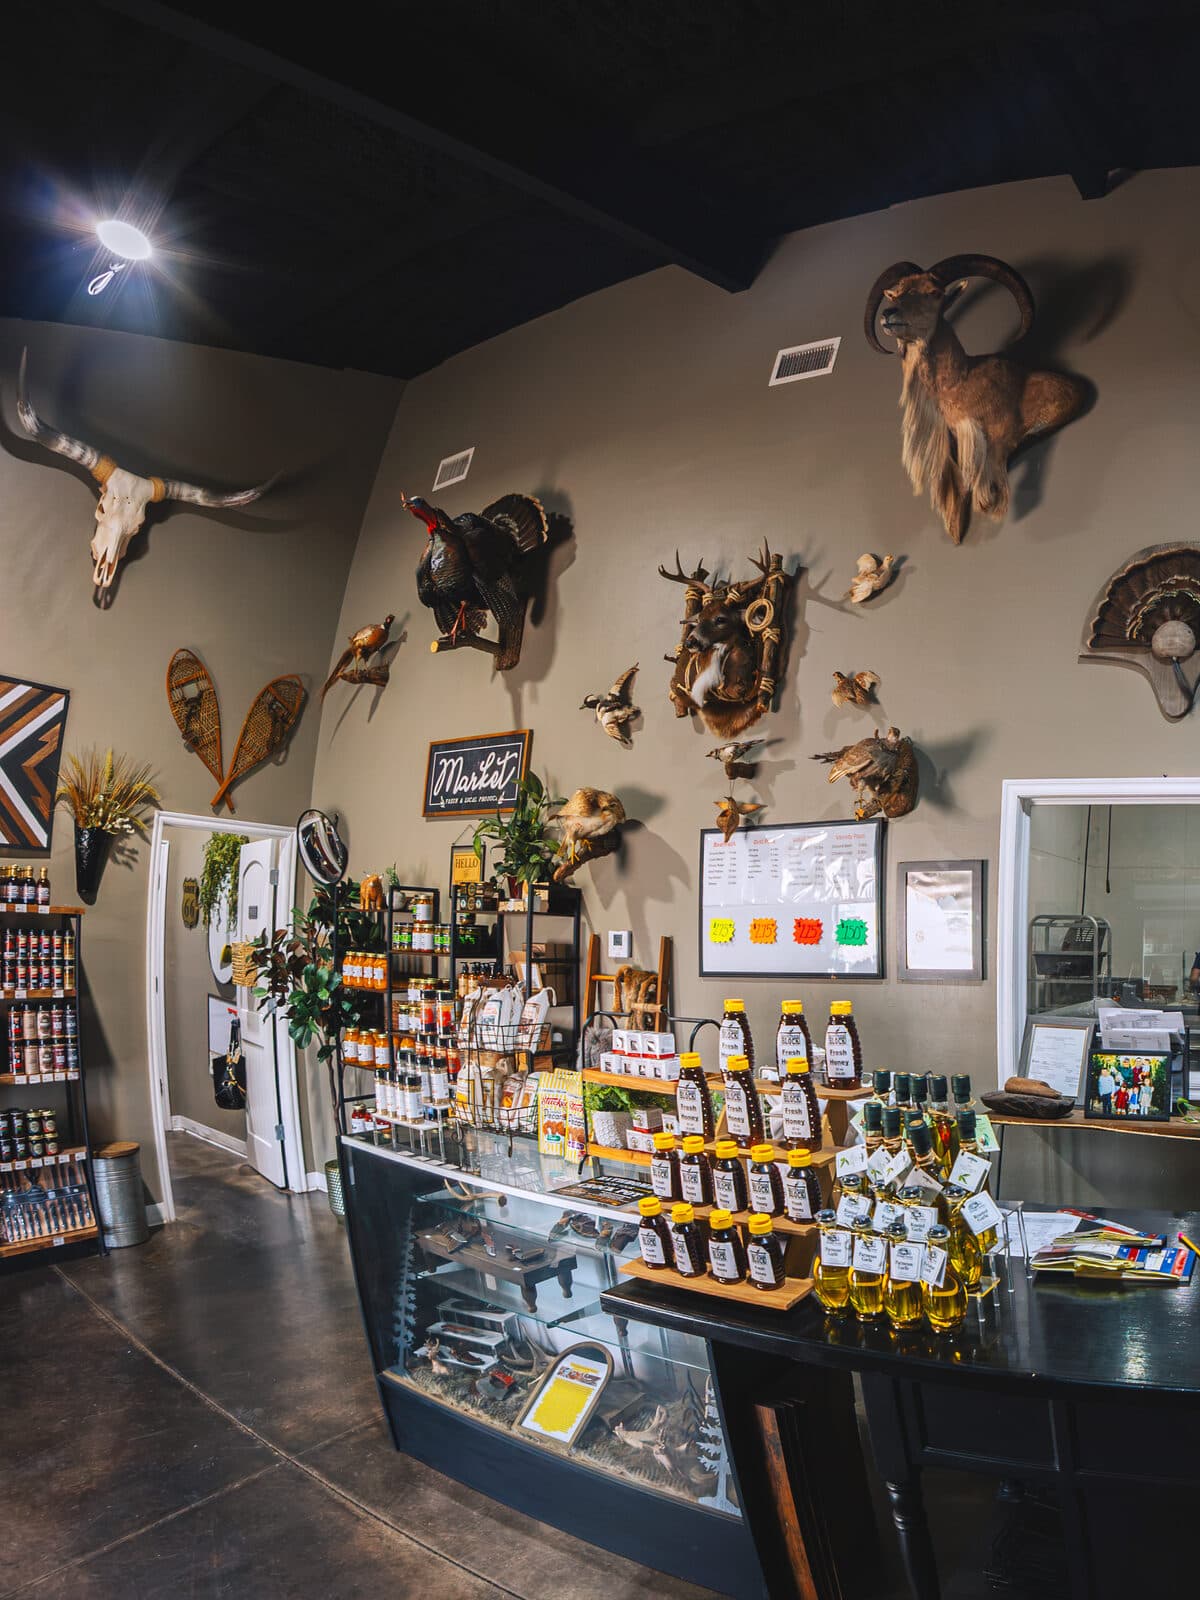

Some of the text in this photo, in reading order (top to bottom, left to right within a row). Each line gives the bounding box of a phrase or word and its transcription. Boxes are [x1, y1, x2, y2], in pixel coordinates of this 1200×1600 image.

[433, 751, 518, 796] Market
[455, 858, 479, 869] HELLO
[829, 1059, 849, 1067] Honey
[727, 1105, 743, 1113] Fresh
[784, 1107, 803, 1115] Fresh
[785, 1117, 805, 1126] Honey
